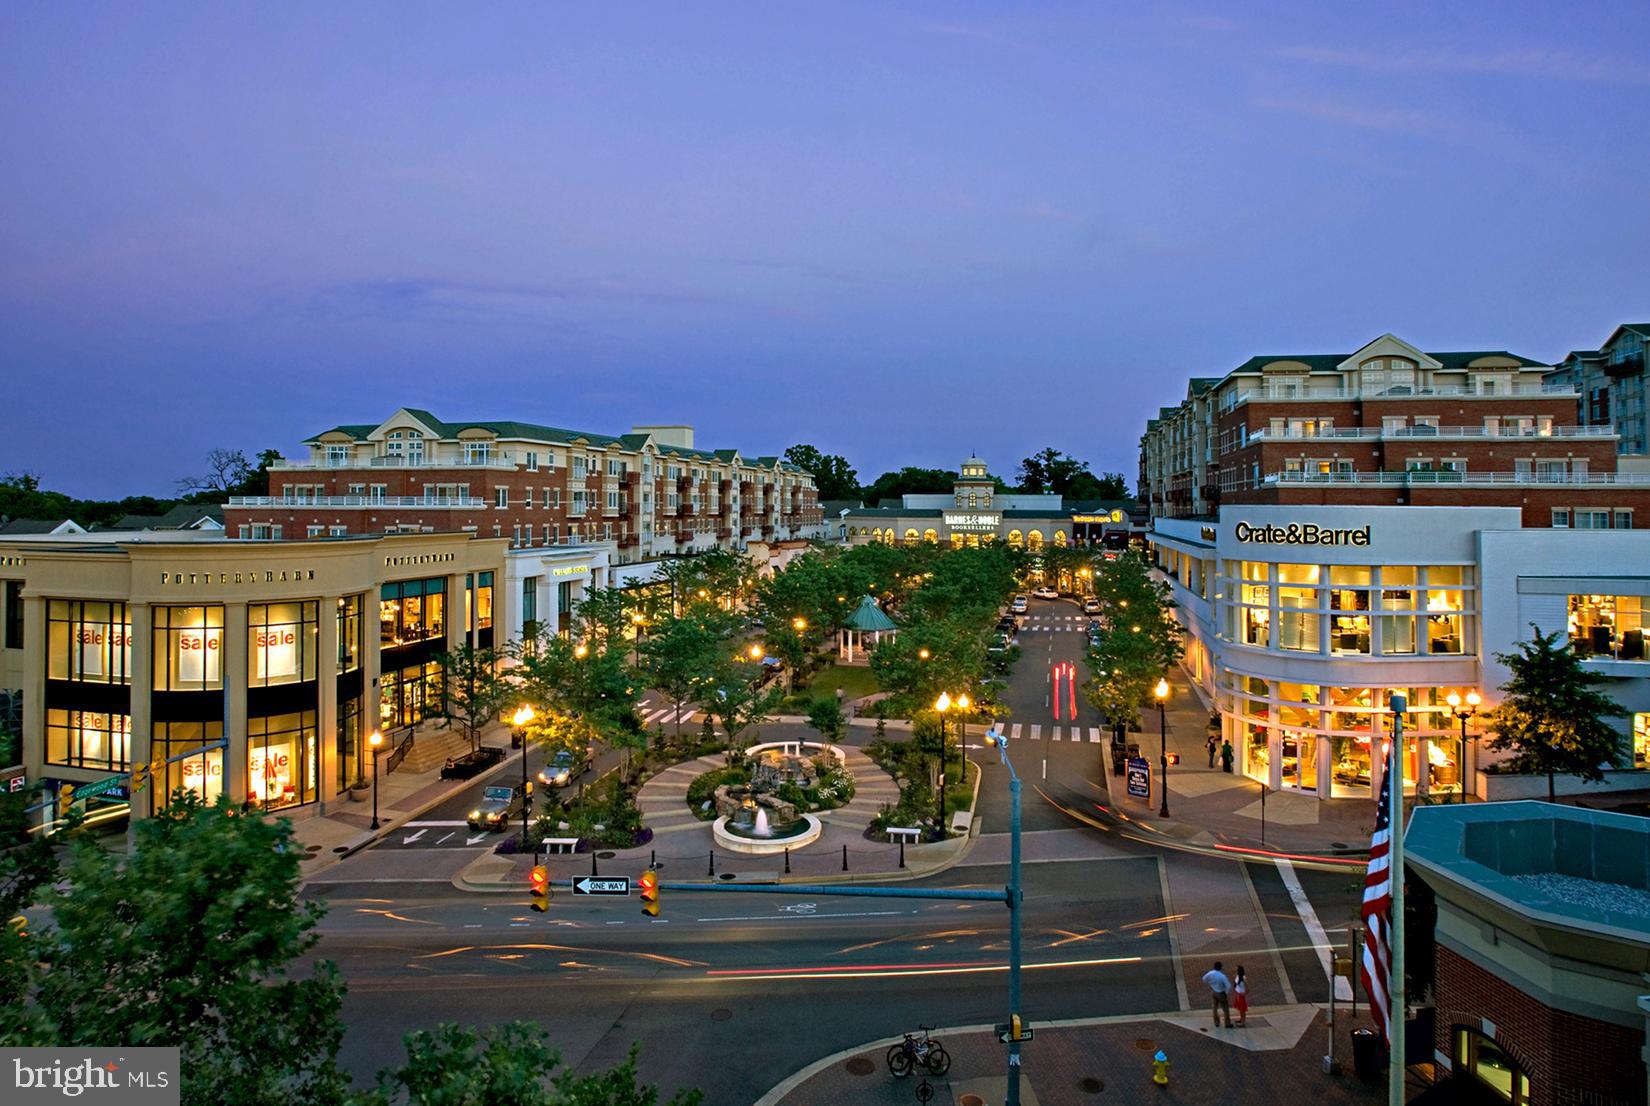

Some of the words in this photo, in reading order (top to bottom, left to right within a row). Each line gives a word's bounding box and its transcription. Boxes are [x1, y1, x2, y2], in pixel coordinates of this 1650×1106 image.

[1235, 521, 1371, 546] Crate&Barrel
[181, 633, 218, 650] sae
[257, 630, 295, 647] sale
[590, 881, 606, 890] ONE
[607, 882, 624, 890] WAY
